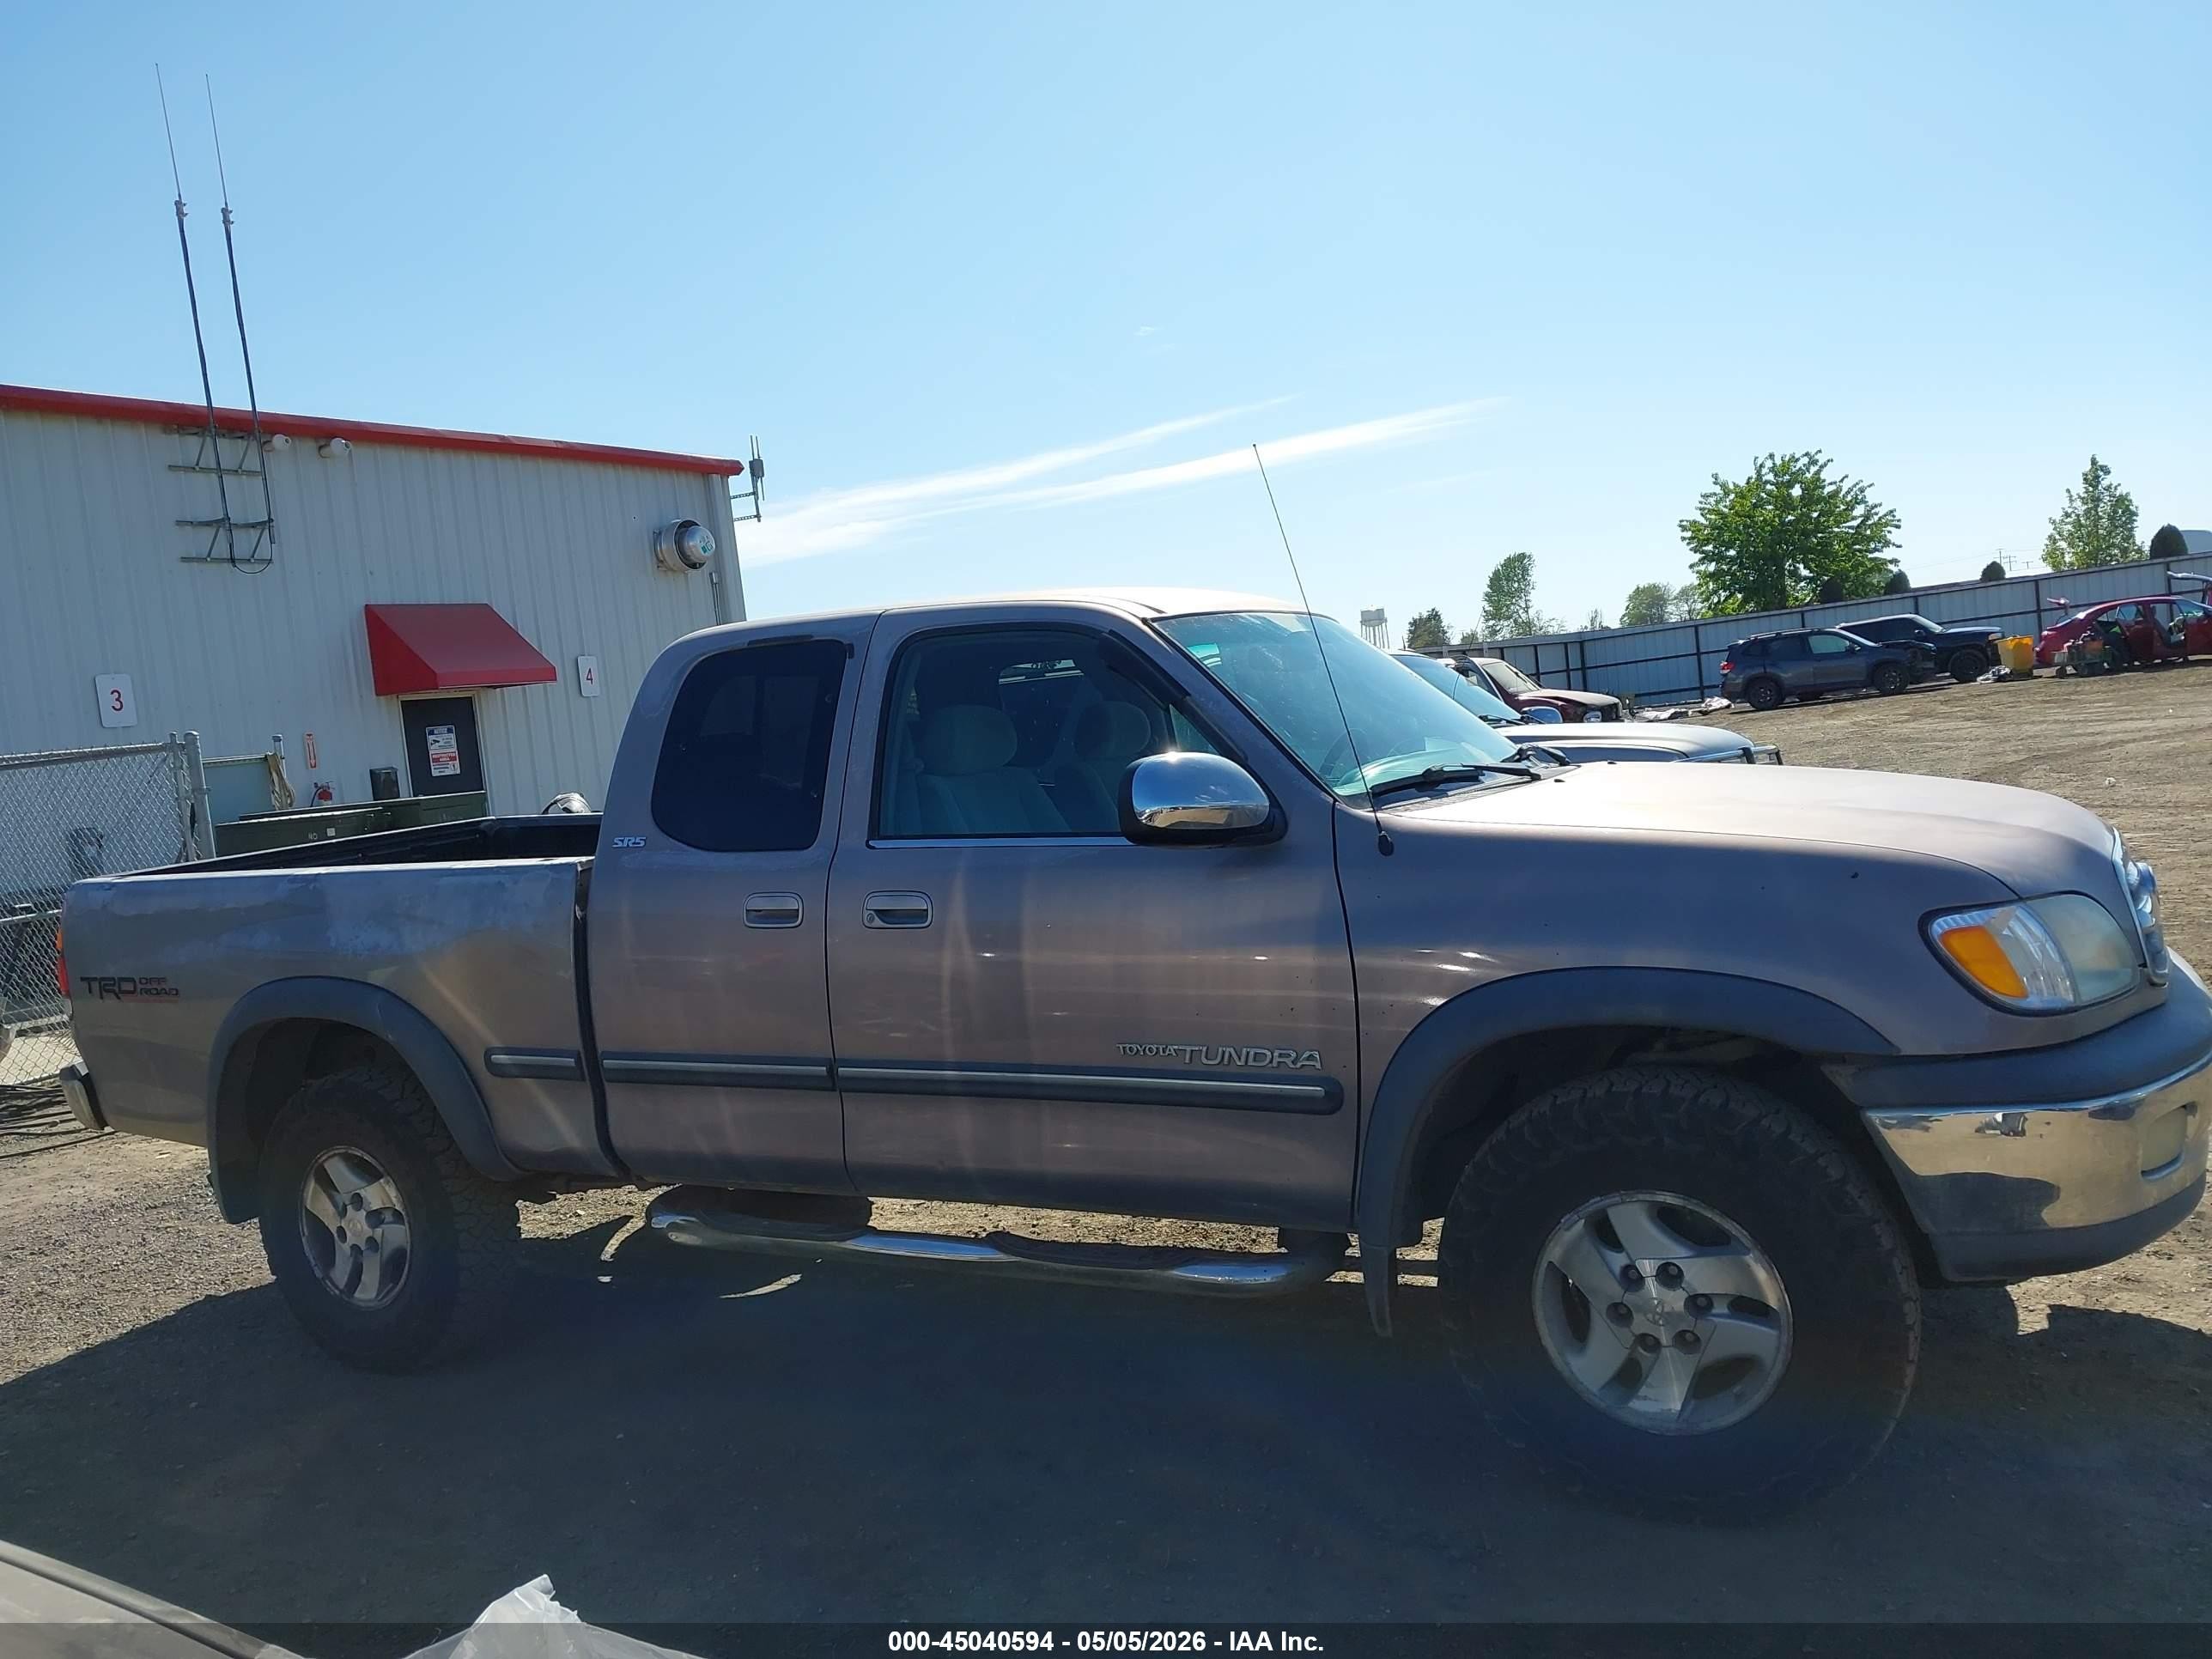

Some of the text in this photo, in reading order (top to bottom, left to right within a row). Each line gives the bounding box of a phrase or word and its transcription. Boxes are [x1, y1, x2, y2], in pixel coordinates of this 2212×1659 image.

[586, 667, 593, 685] 4
[110, 689, 124, 712] 3
[611, 836, 647, 848] SR5
[80, 975, 137, 1000] TRD
[138, 976, 167, 986] OFF
[139, 987, 179, 997] ROAD
[1116, 1042, 1322, 1071] TOYOTA TUNDRA
